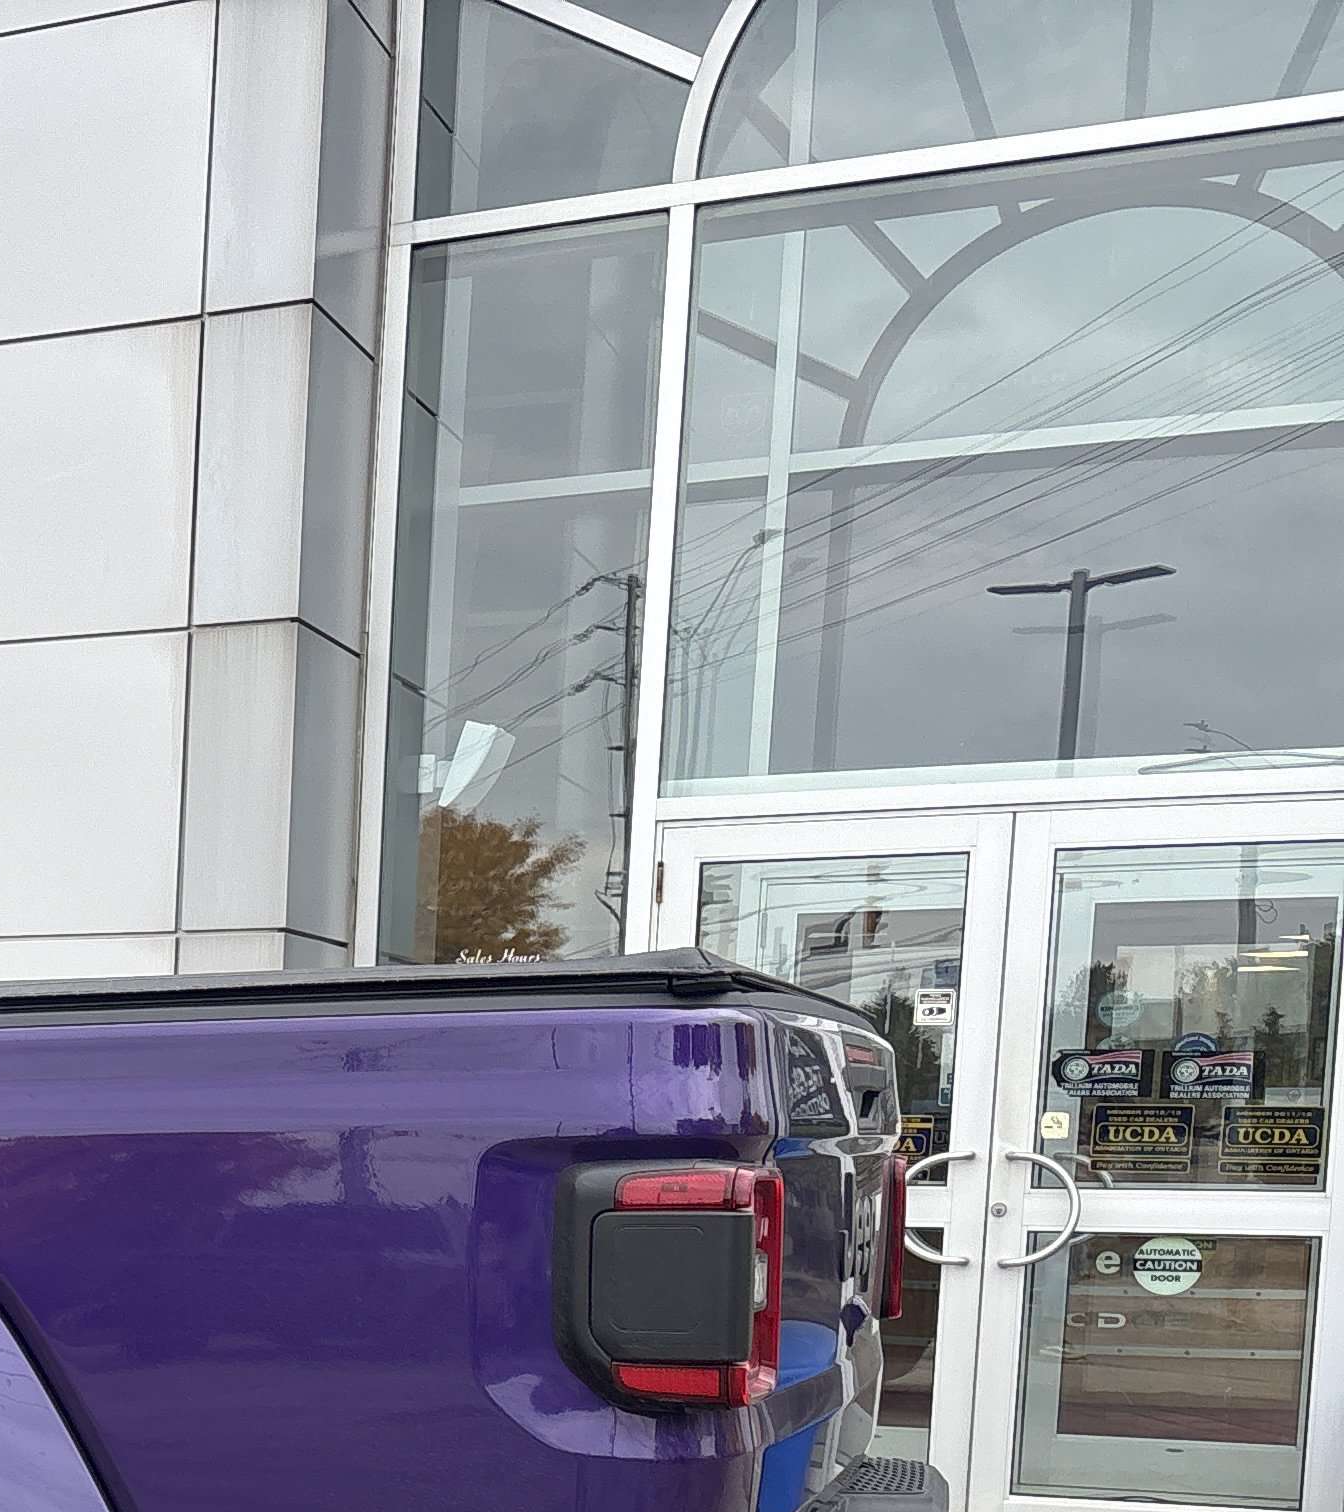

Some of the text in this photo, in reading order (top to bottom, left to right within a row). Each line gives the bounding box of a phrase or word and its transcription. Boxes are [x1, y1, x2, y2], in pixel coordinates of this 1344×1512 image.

[455, 947, 543, 964] Sales Hours
[1091, 1063, 1137, 1075] TADA
[1202, 1065, 1249, 1077] TADA
[1108, 1126, 1179, 1143] UCDA
[1237, 1128, 1309, 1144] UCDA
[1137, 1248, 1196, 1256] AUTOMATIC
[1135, 1260, 1198, 1271] CAUTION
[1150, 1274, 1181, 1282] DOOR
